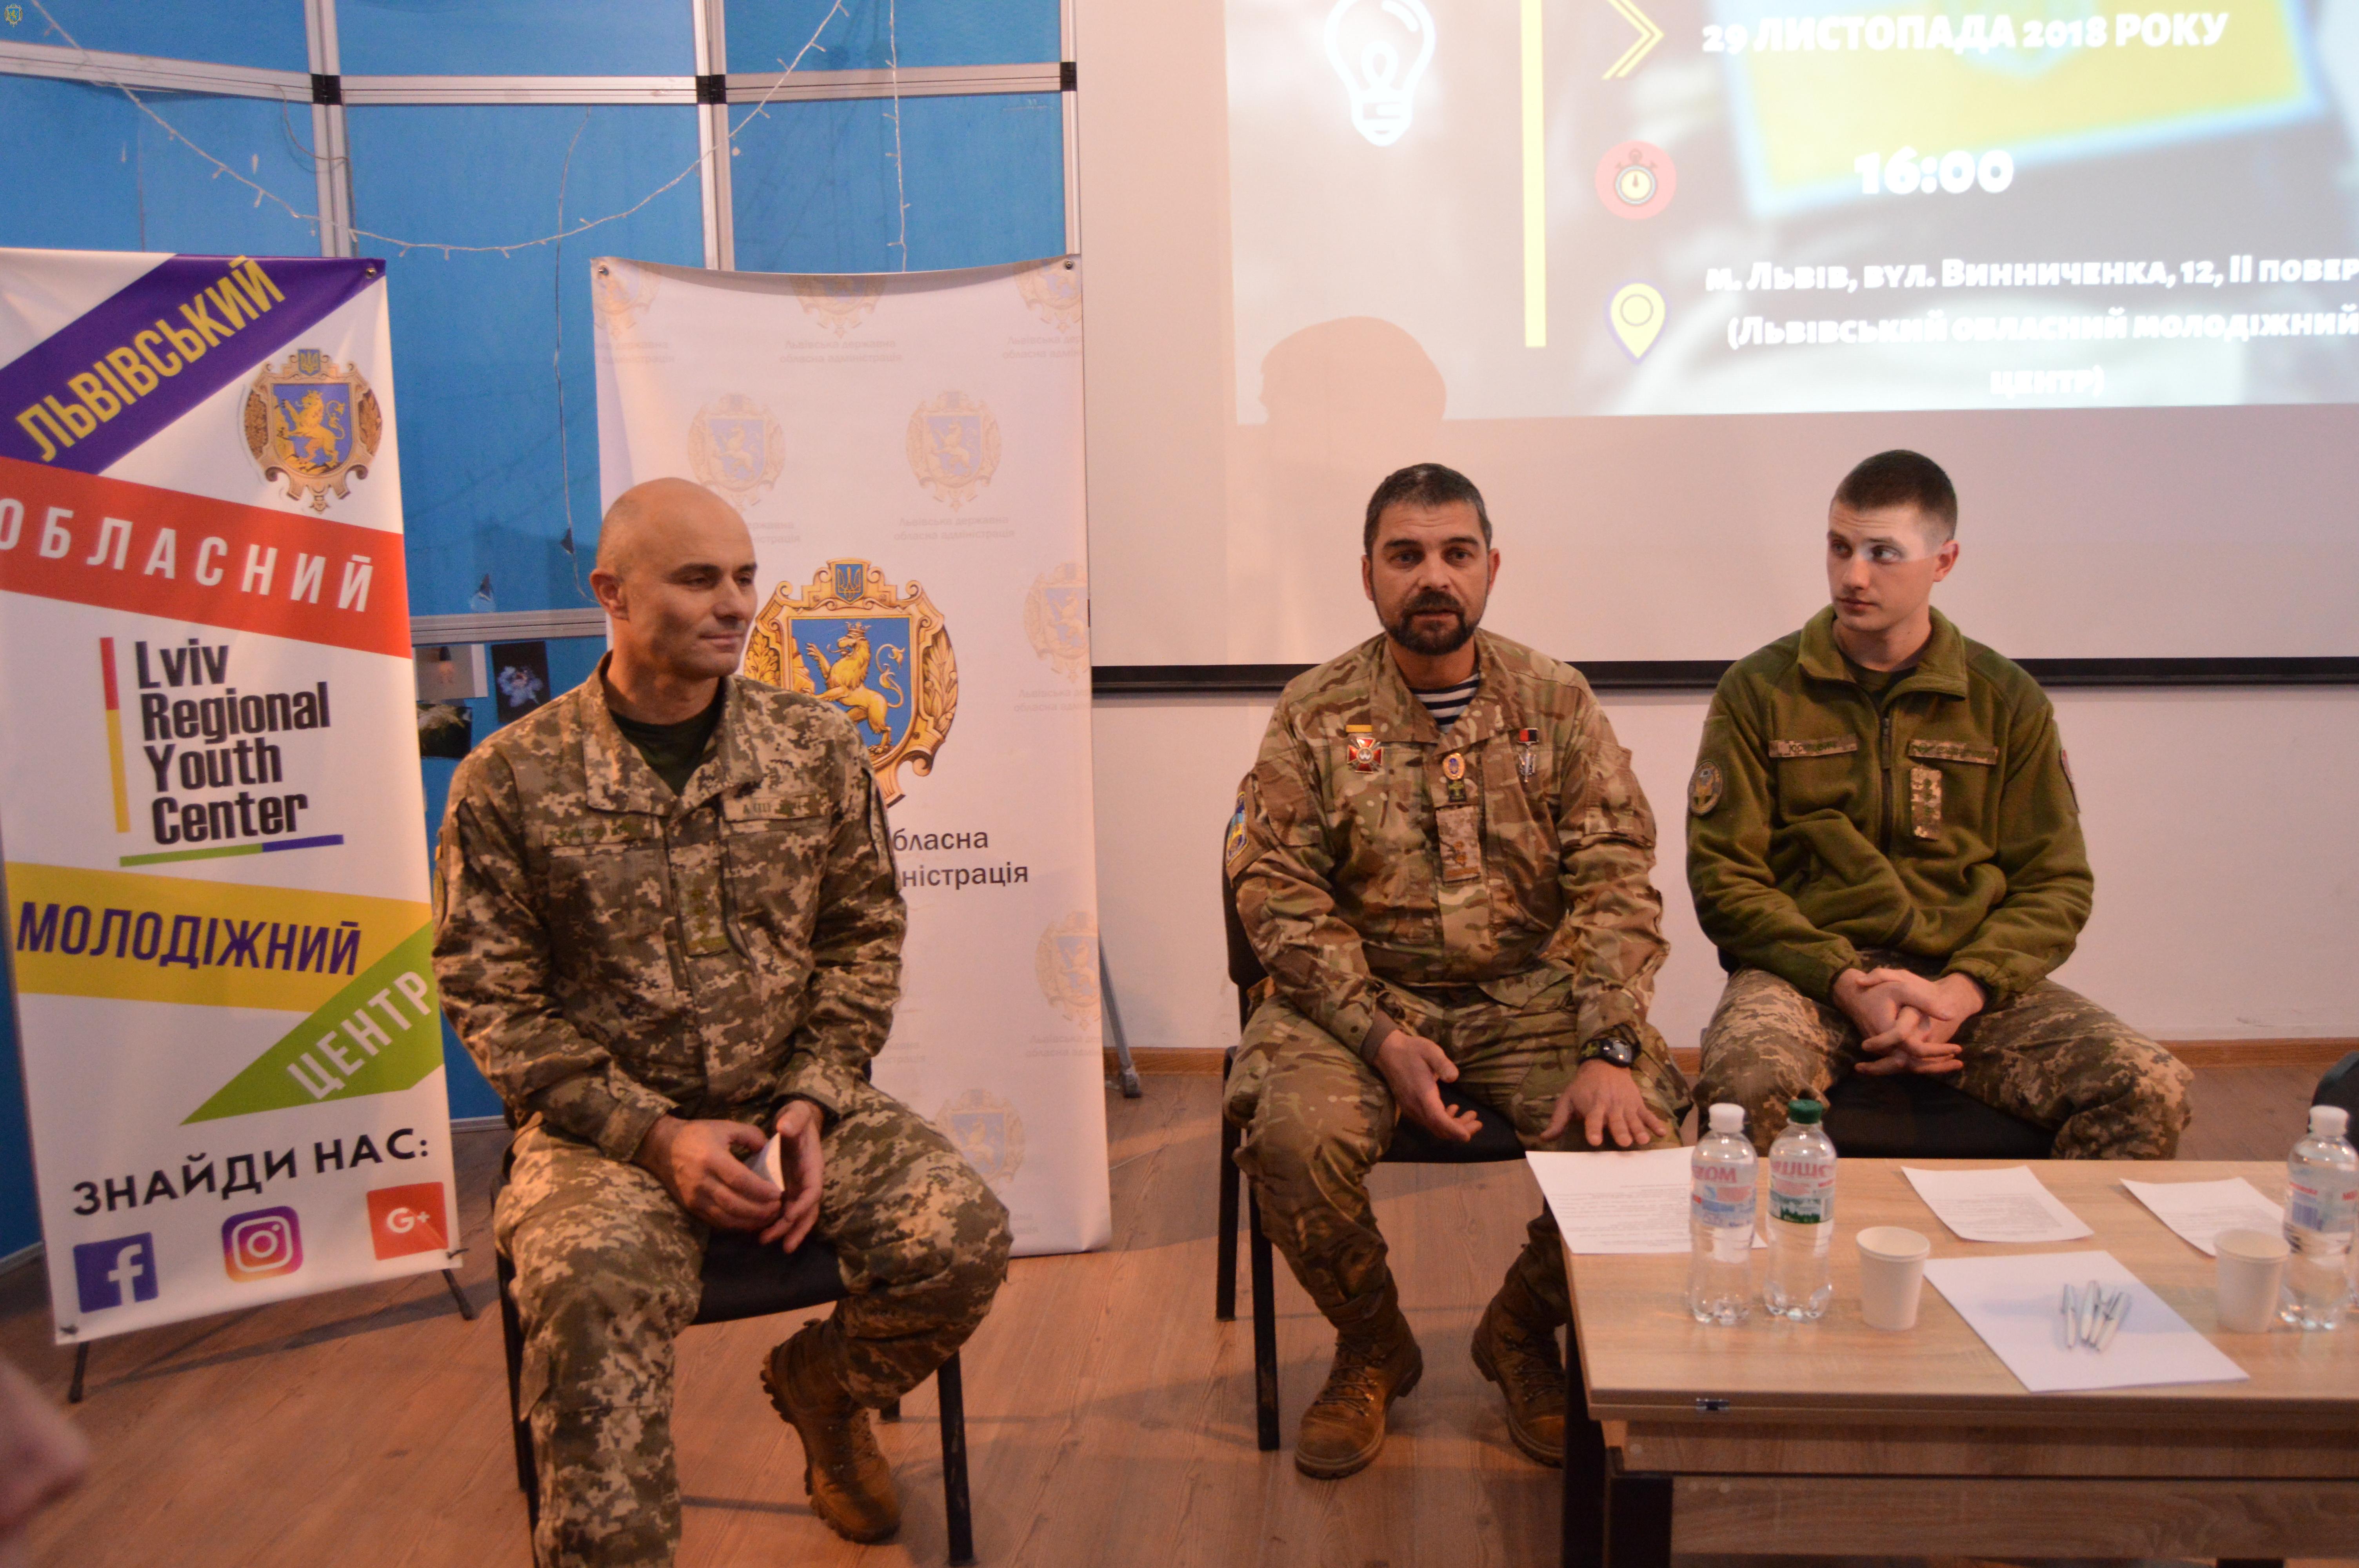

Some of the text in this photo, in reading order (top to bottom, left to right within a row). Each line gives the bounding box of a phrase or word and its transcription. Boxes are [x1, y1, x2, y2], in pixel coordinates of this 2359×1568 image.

[1702, 12, 2230, 55] 29 ЛИСТОПАДА 2018 РОКУ
[1854, 145, 2014, 195] 16:00
[2180, 261, 2224, 288] 12,
[15, 255, 286, 462] ЛЬВІВСЬКИЙ
[0, 497, 374, 612] ОБЛАСНИЙ
[135, 638, 229, 689] Lviv
[140, 681, 331, 744] Regional
[144, 737, 283, 792] Youth
[152, 791, 308, 845] Center
[893, 828, 989, 851] бласна
[902, 862, 1028, 890] ністрація
[16, 901, 362, 976] МОЛОДІЖНИЙ
[287, 971, 432, 1101] ЦЕНТР
[73, 1128, 429, 1216] ЗНАЙДИ НАС:
